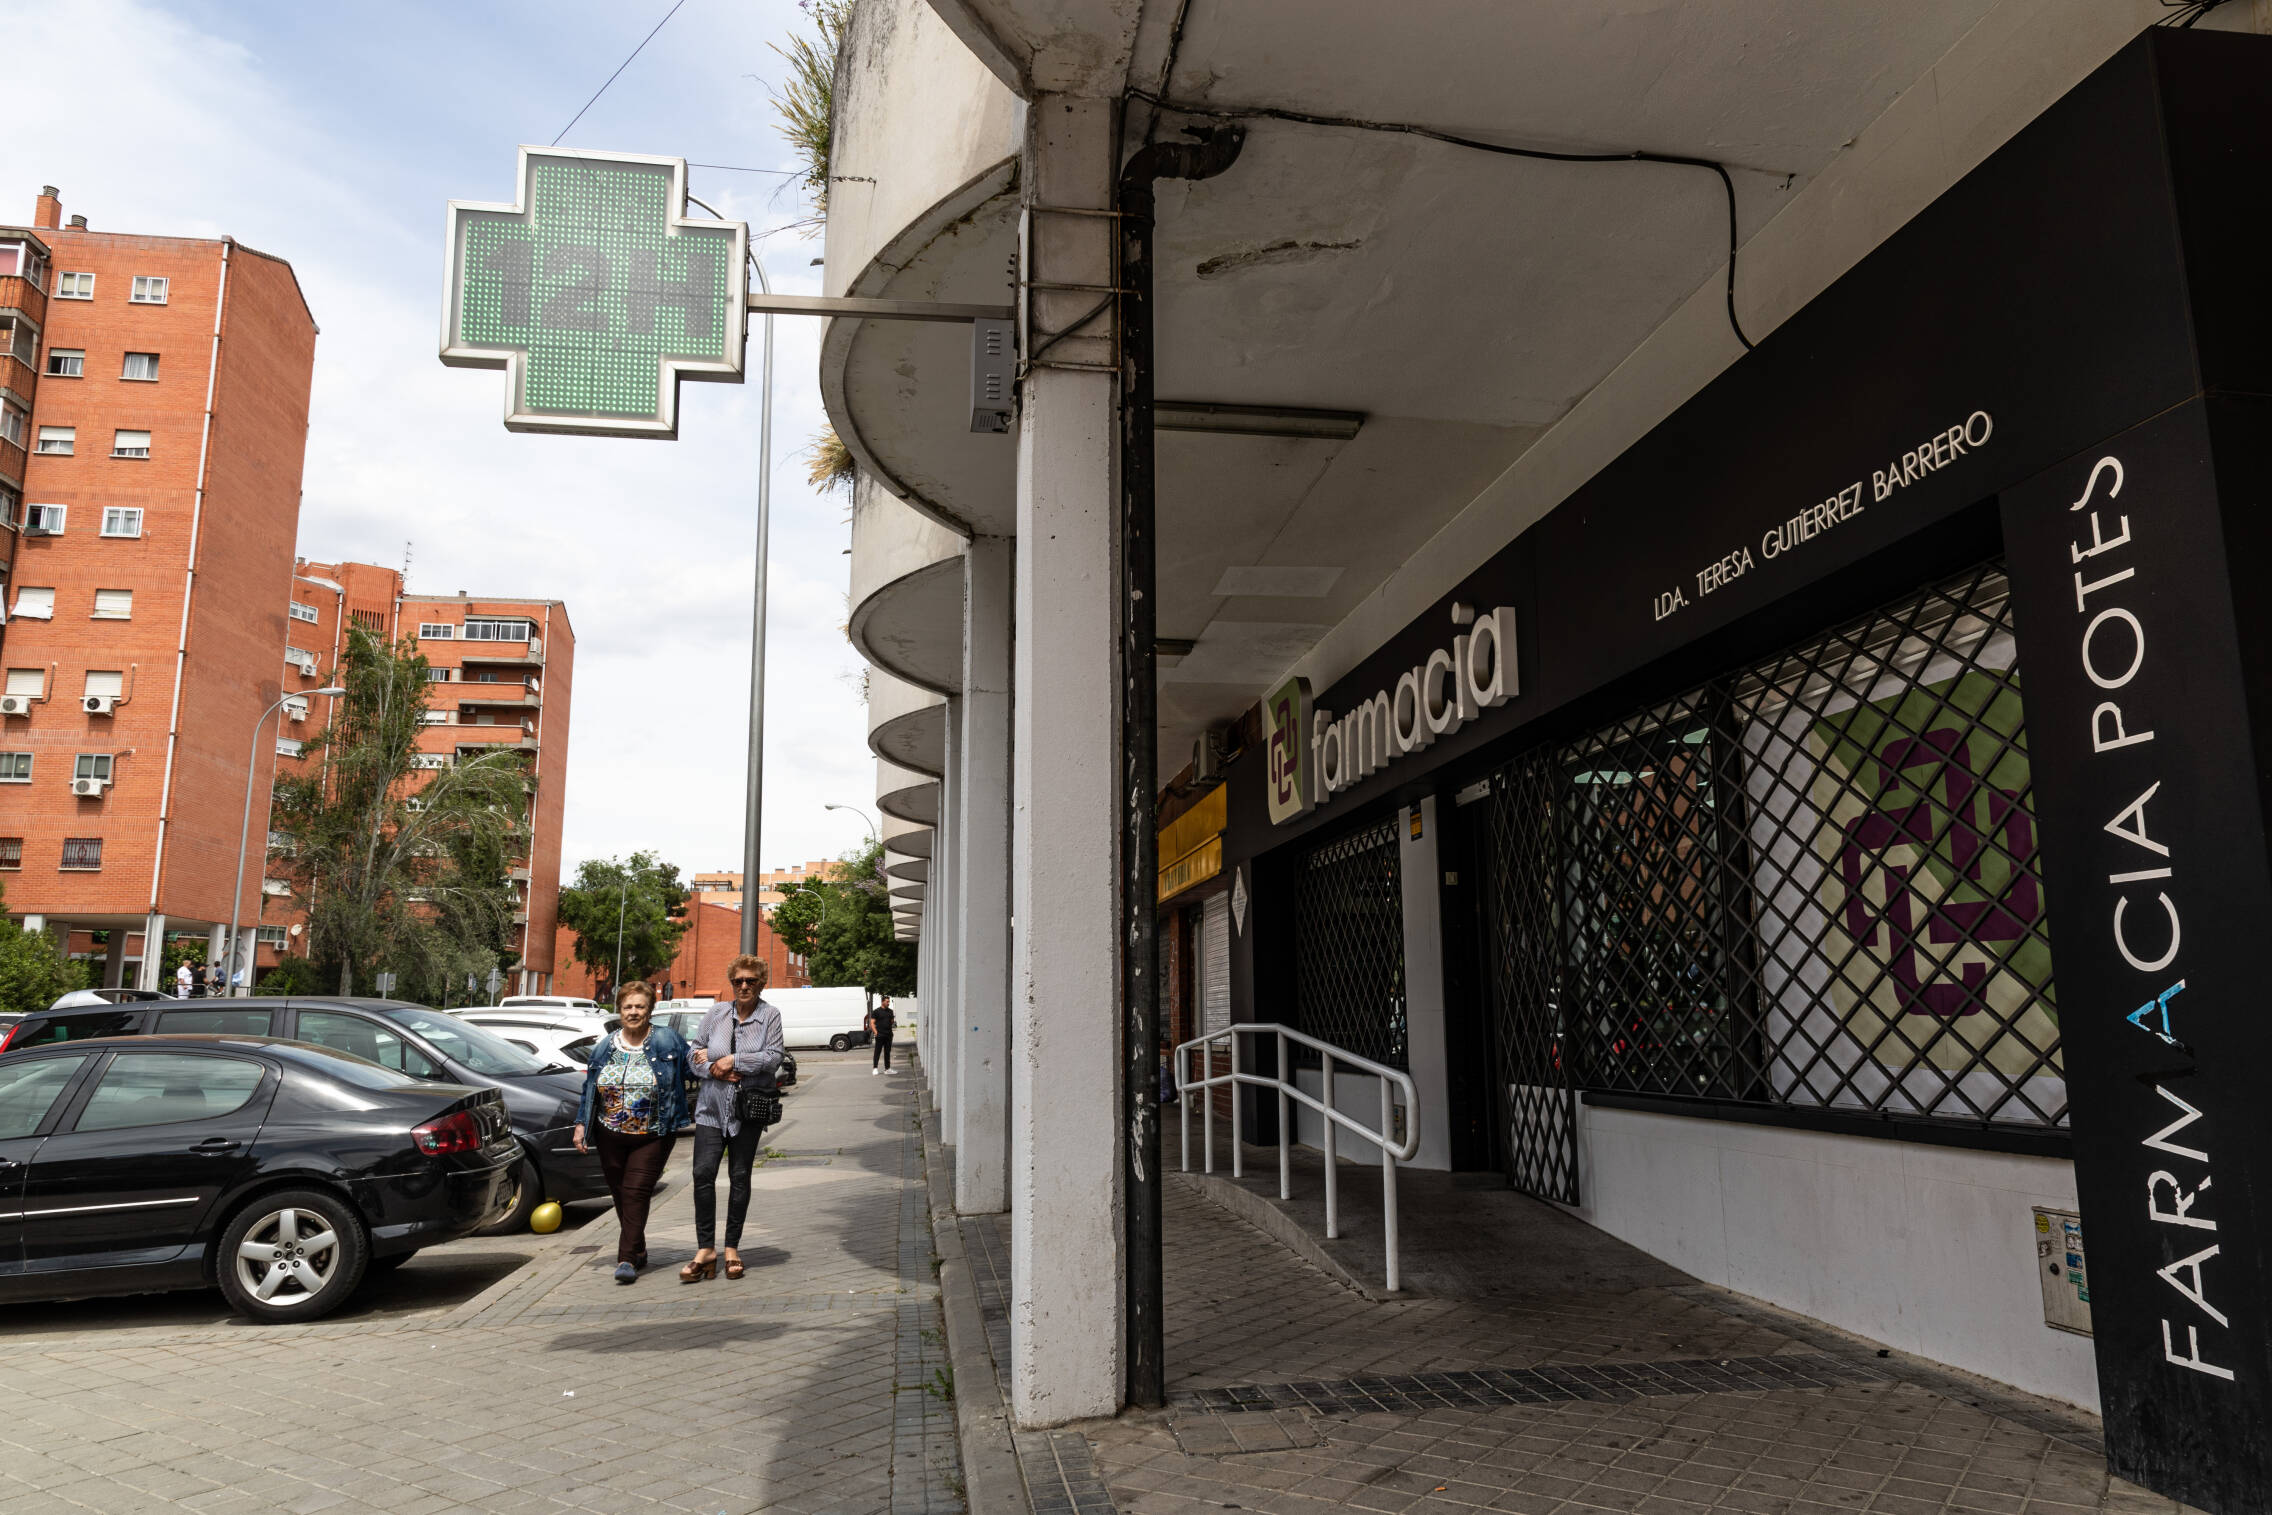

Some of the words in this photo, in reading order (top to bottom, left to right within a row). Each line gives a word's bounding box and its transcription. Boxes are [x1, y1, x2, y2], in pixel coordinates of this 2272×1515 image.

[1654, 586, 1690, 621] LDA.
[1696, 546, 1756, 597] TERESA
[1872, 410, 1993, 502] BARRERO
[2069, 456, 2155, 753] POTES
[1311, 601, 1520, 804] farmacia
[2103, 780, 2235, 1381] FARMACIA
